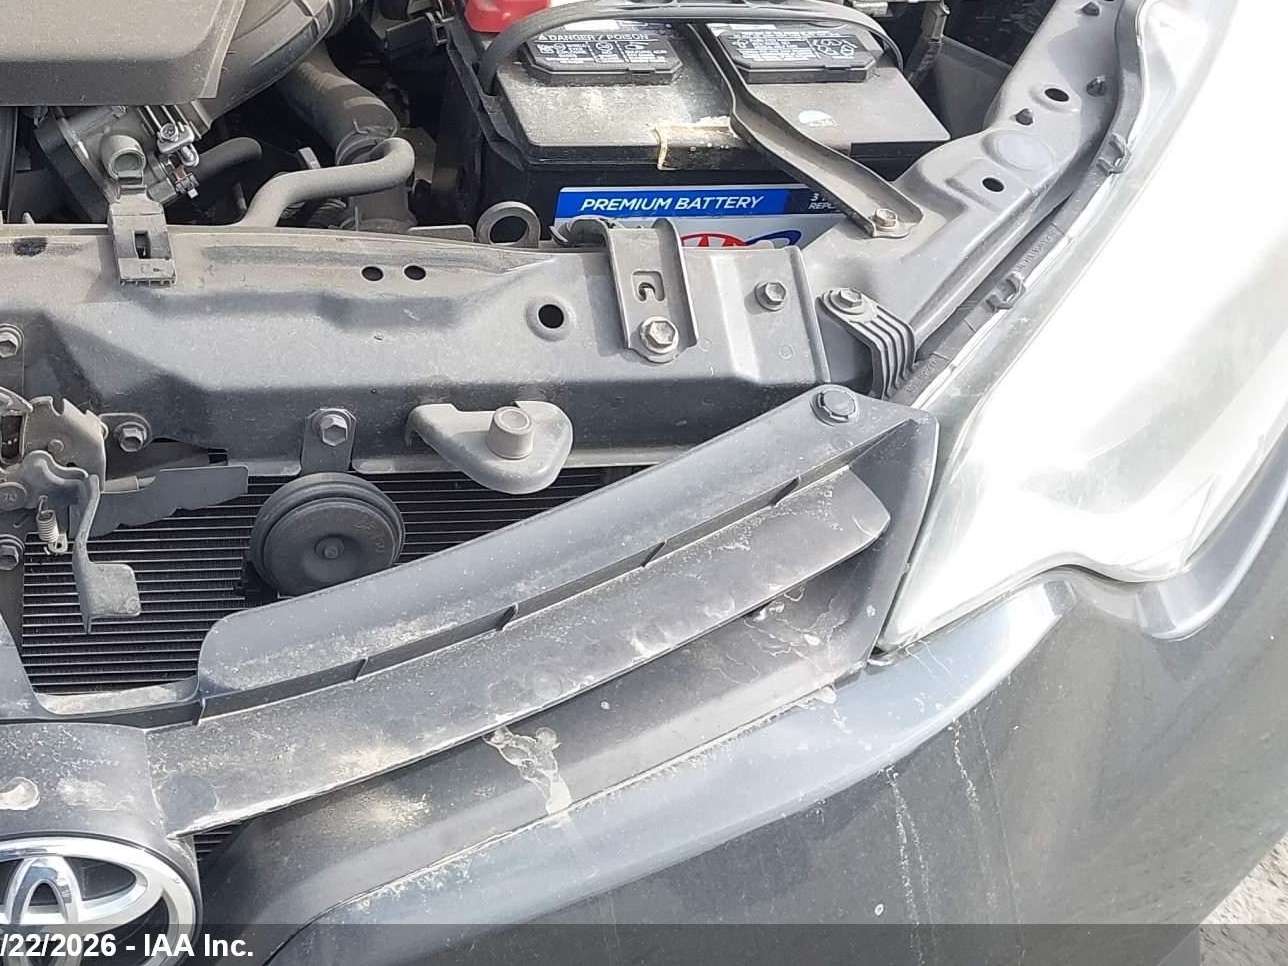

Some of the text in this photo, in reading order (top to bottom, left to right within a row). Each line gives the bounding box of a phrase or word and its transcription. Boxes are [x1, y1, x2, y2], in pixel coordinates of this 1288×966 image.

[548, 33, 595, 41] DANGER
[605, 33, 650, 41] POISON
[580, 195, 765, 212] PREMIUM BATTERY
